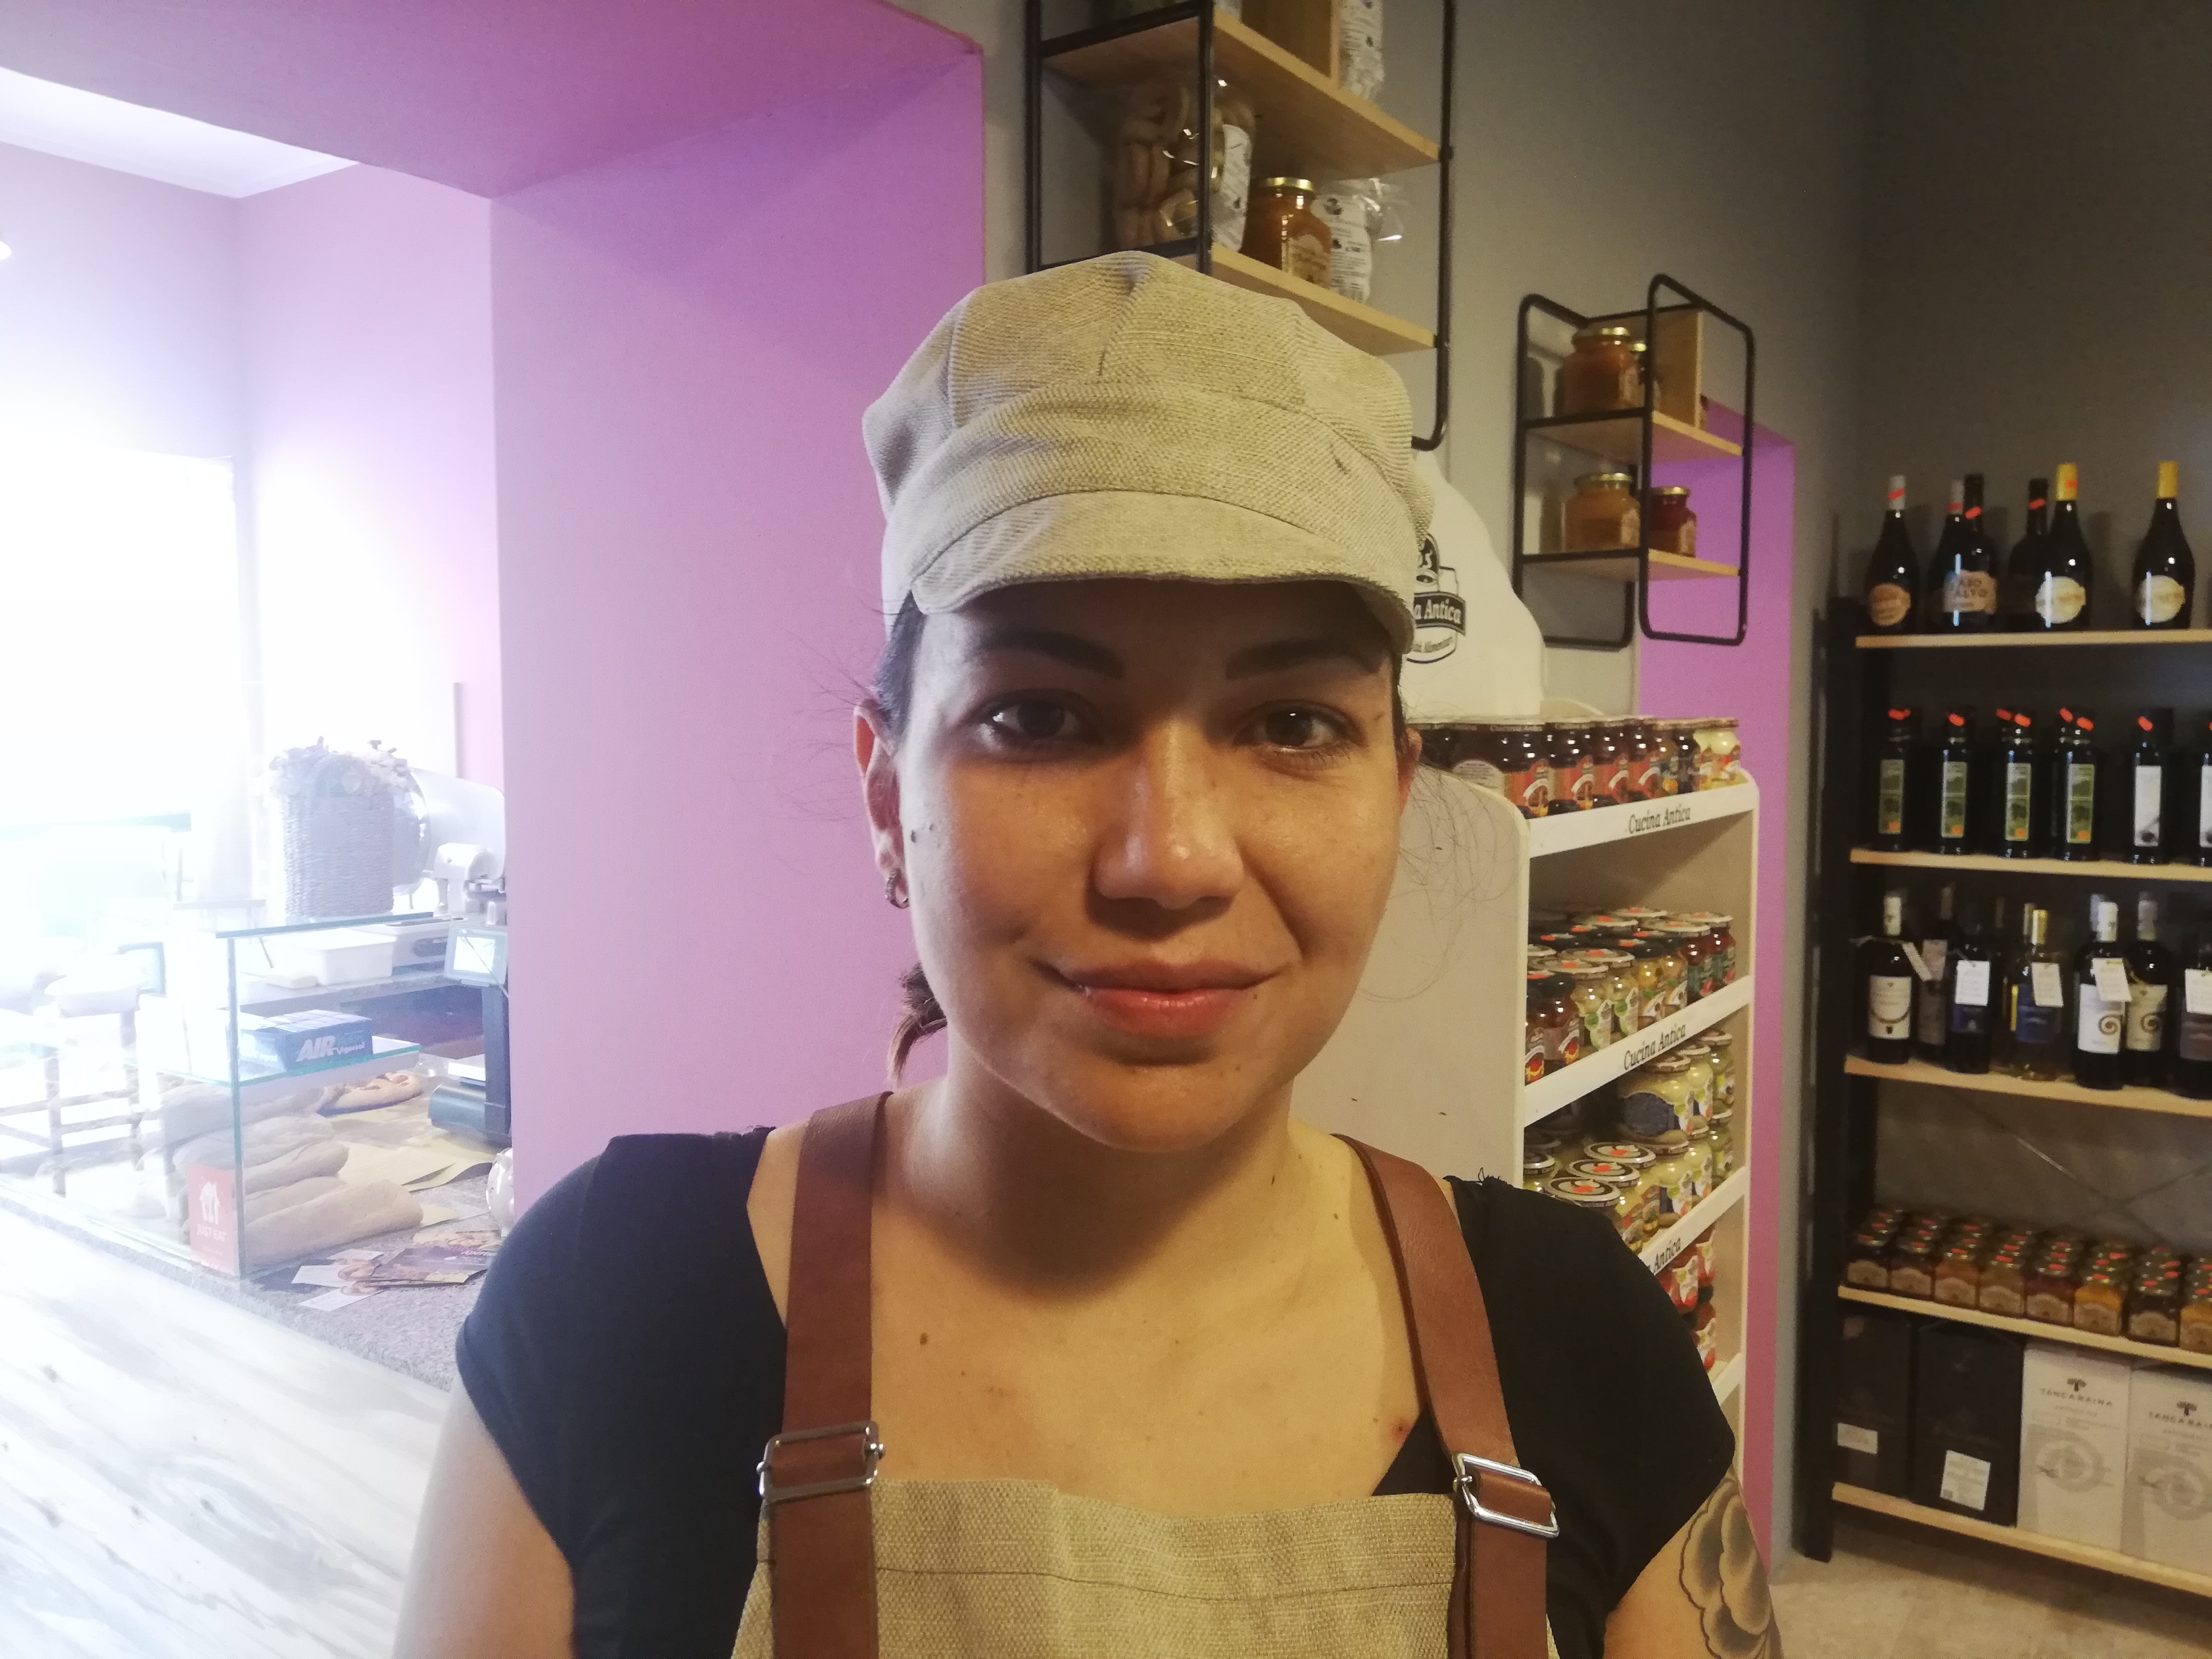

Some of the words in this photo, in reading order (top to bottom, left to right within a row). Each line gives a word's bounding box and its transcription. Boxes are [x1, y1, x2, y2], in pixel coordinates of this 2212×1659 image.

[1424, 599, 1462, 624] Antica
[1629, 809, 1661, 834] Cucina
[1662, 803, 1691, 827] Antica
[296, 1035, 336, 1062] AIR
[1624, 1040, 1656, 1070] Cucina
[1658, 1023, 1686, 1052] Antica
[196, 1223, 212, 1237] JUST
[213, 1229, 228, 1242] EAT
[1653, 1237, 1681, 1274] Antica
